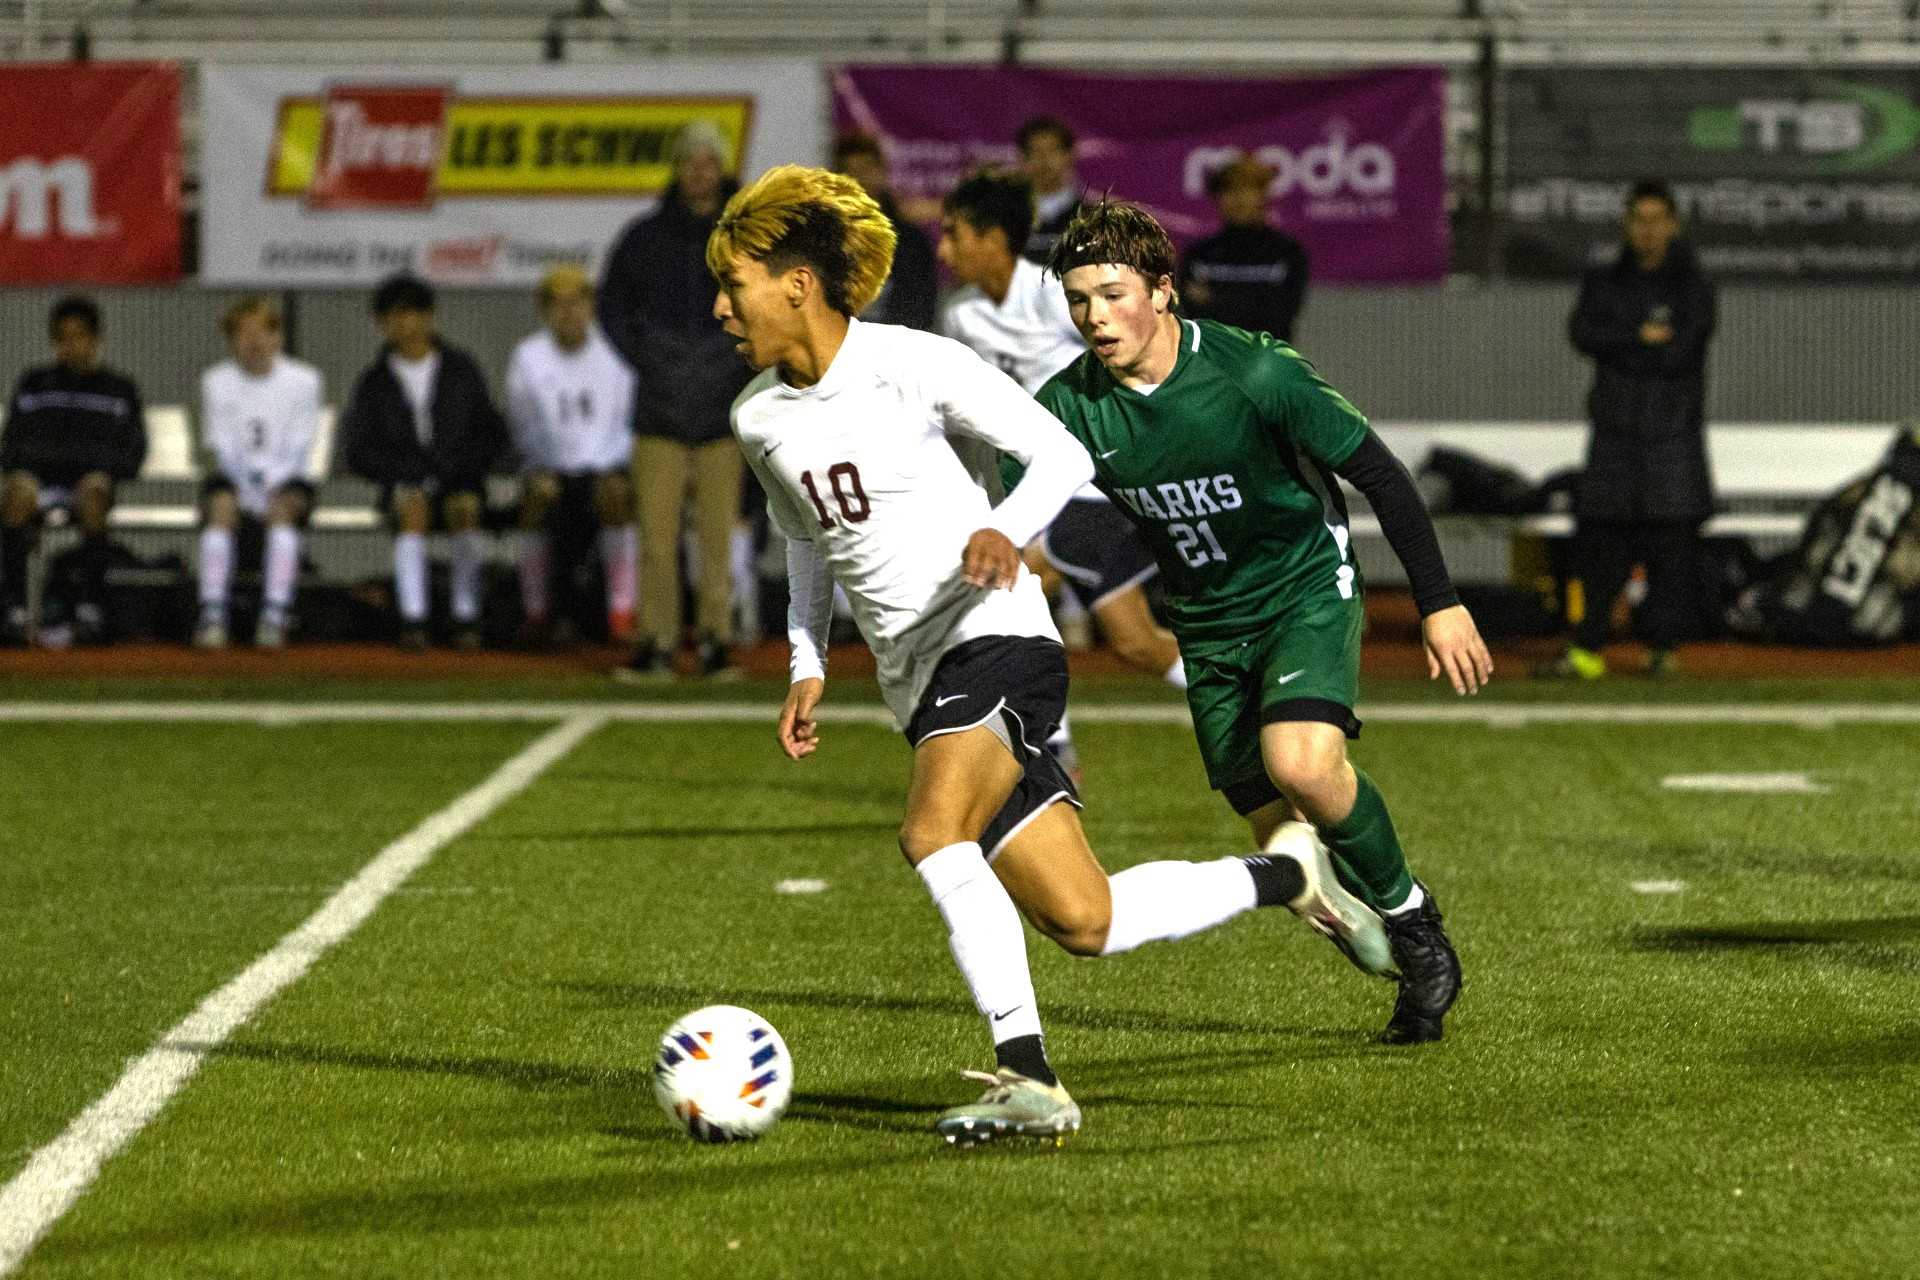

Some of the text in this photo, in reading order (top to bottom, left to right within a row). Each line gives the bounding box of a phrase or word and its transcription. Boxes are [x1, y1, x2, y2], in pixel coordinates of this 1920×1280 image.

[450, 122, 522, 169] LES
[801, 460, 871, 529] 10
[1114, 474, 1243, 520] VARKS
[1167, 520, 1227, 568] 21
